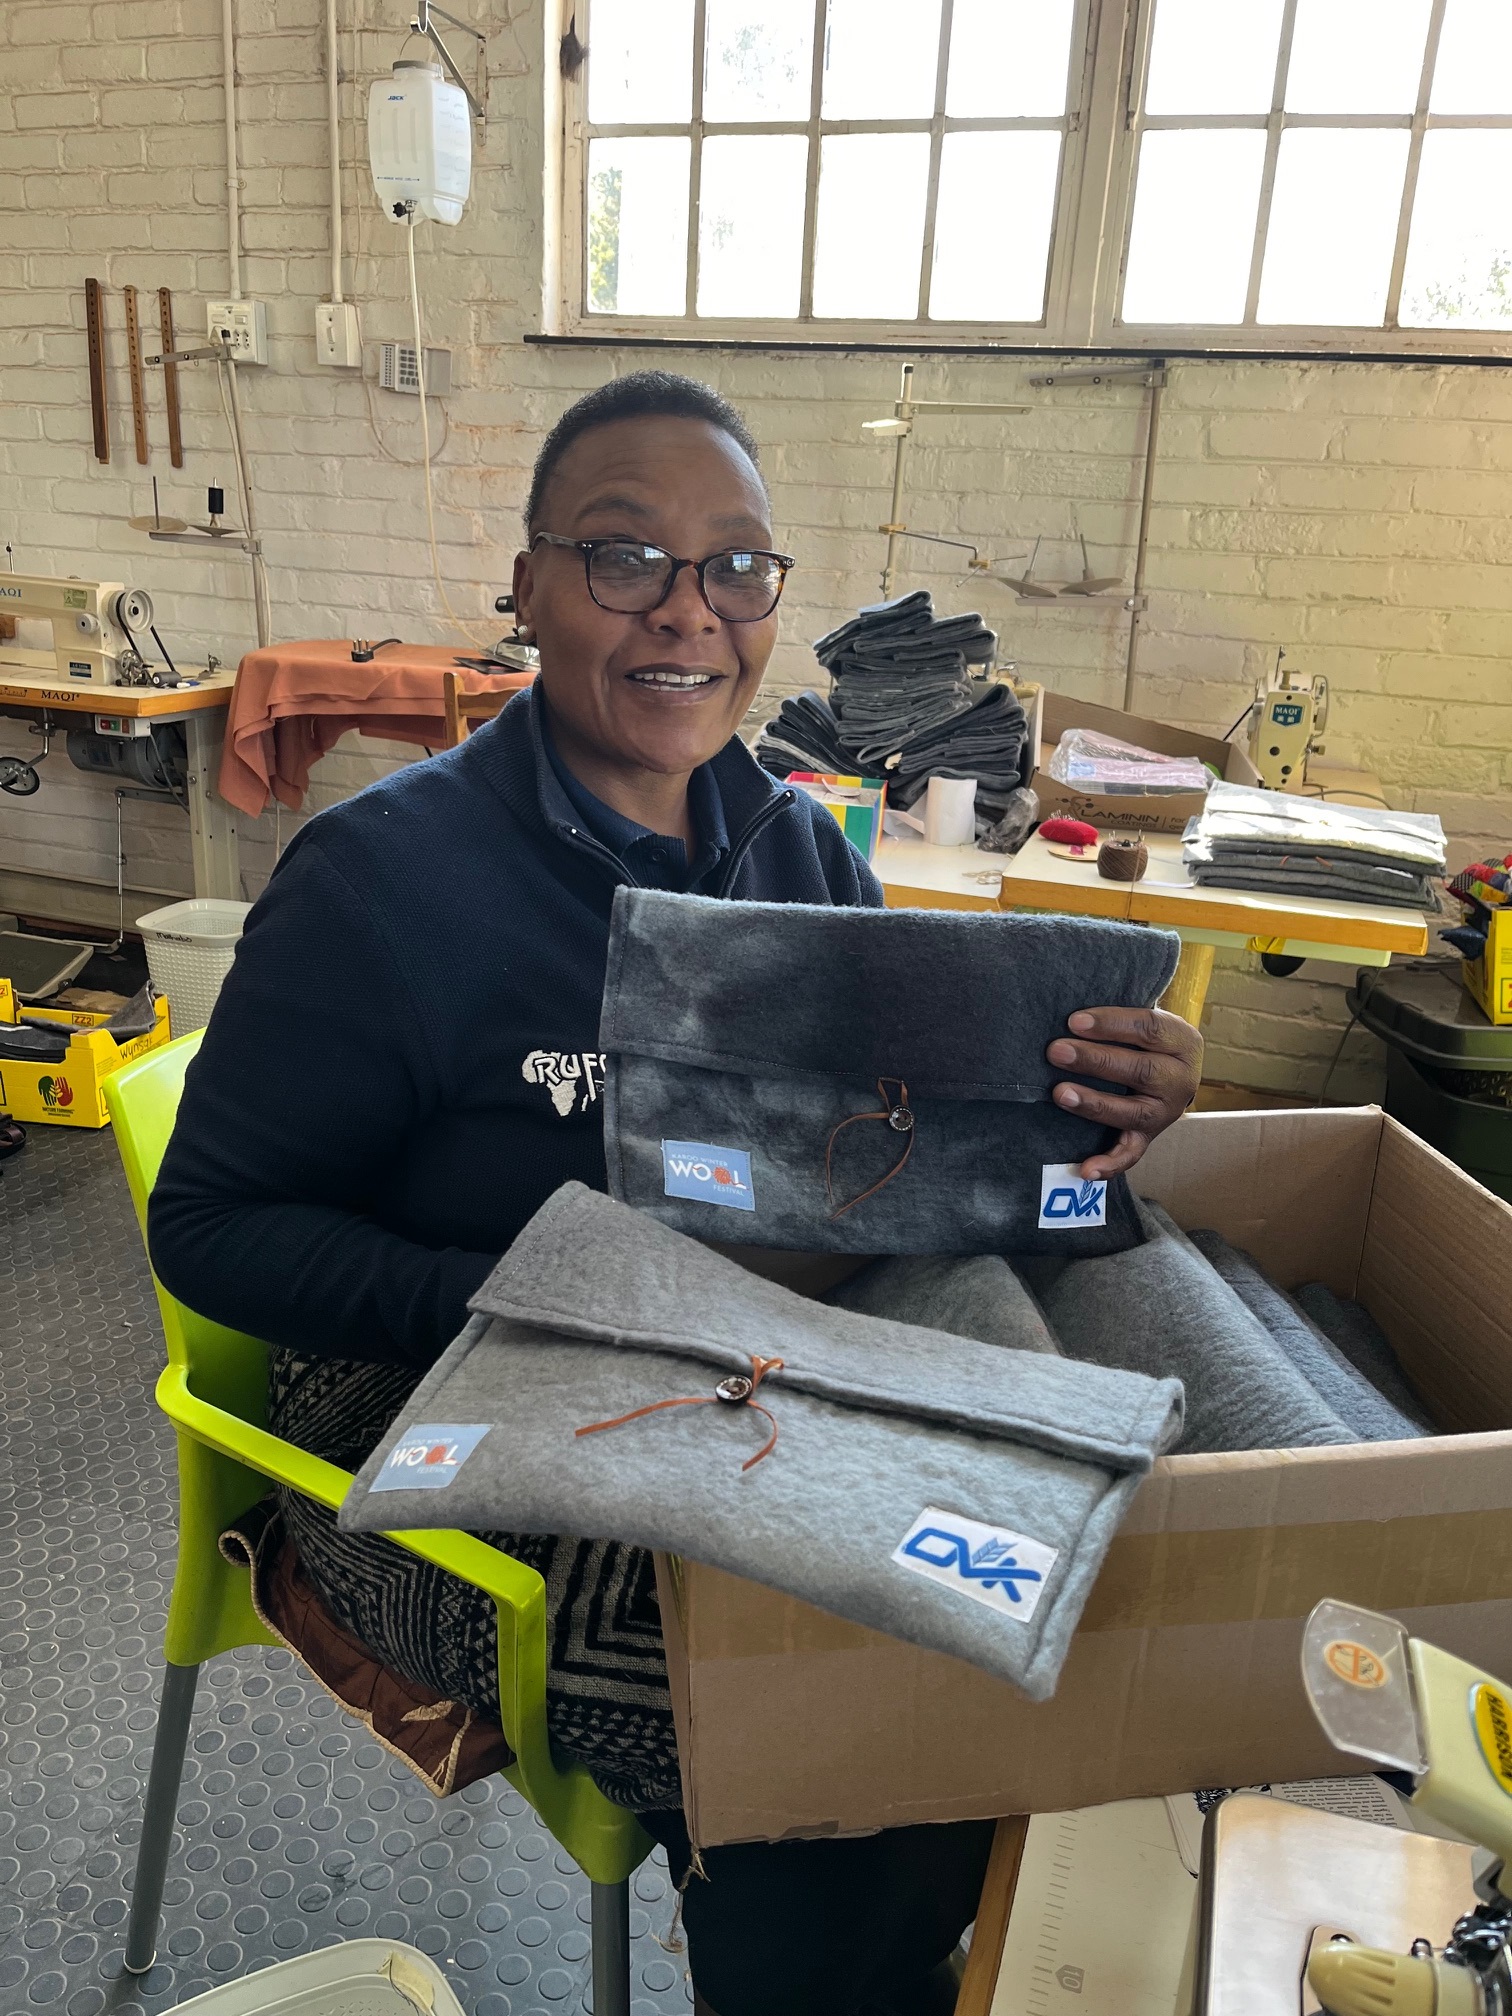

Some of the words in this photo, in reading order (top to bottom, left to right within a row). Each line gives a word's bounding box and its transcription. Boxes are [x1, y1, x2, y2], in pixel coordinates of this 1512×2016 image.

[1081, 809, 1161, 823] LAMININ
[1111, 820, 1158, 829] COATINGS
[73, 1014, 93, 1026] ZZ2
[713, 1184, 745, 1197] FESTIVAL
